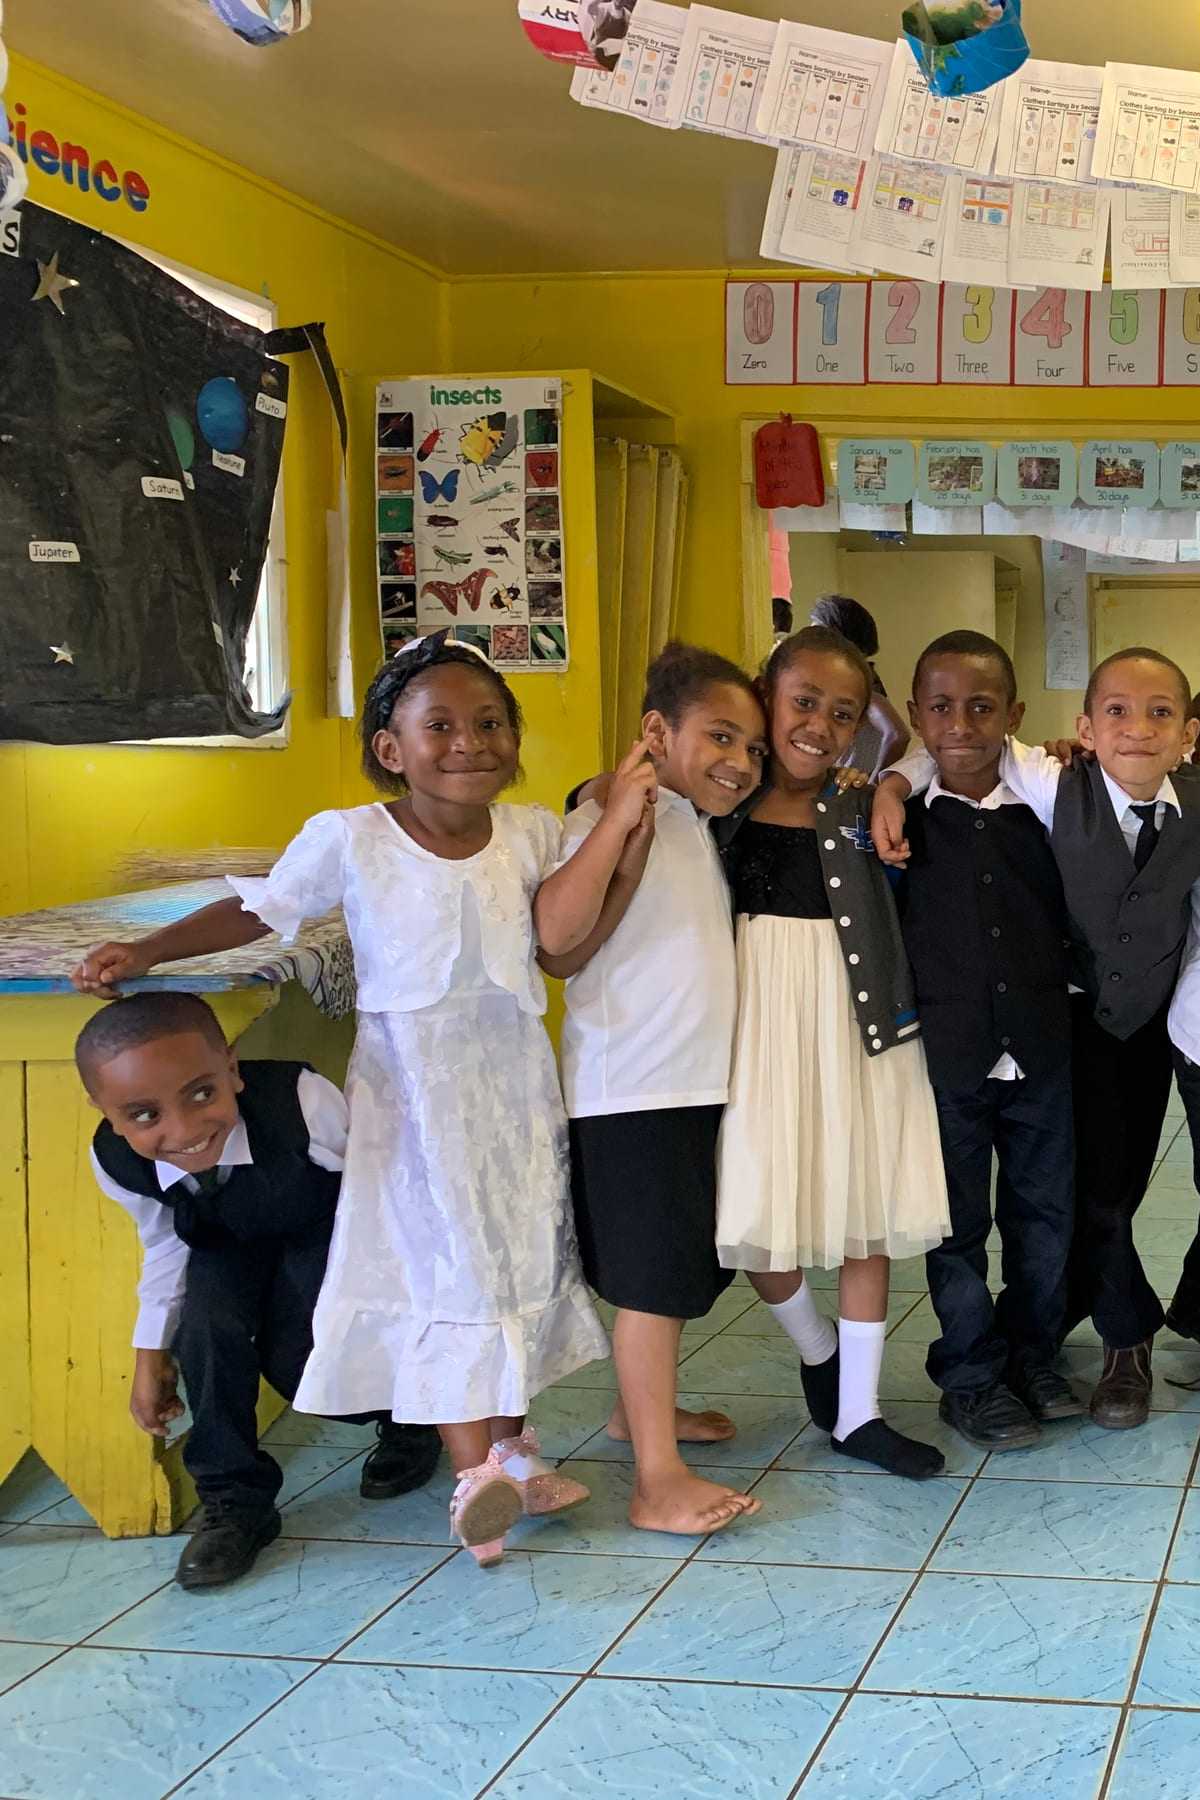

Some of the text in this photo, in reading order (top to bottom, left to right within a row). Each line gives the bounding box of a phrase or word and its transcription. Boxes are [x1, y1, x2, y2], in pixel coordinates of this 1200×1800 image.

[744, 282, 774, 344] 0
[816, 282, 841, 345] 1
[885, 281, 920, 344] 2
[963, 286, 995, 343] 3
[1020, 288, 1072, 348] 4
[1109, 289, 1139, 345] 5
[742, 354, 767, 369] Zero
[816, 354, 839, 373] One
[885, 354, 914, 373] Two
[955, 354, 989, 374] Three
[1036, 360, 1065, 377] Four
[1107, 354, 1136, 374] Five
[430, 385, 502, 406] insects
[257, 398, 280, 415] Pluto
[849, 443, 903, 456] January has
[926, 442, 981, 456] February has
[1011, 443, 1058, 454] March has
[1092, 443, 1133, 455] April has
[1175, 442, 1196, 458] May
[149, 480, 180, 496] Saturn
[31, 544, 73, 558] Jupiter
